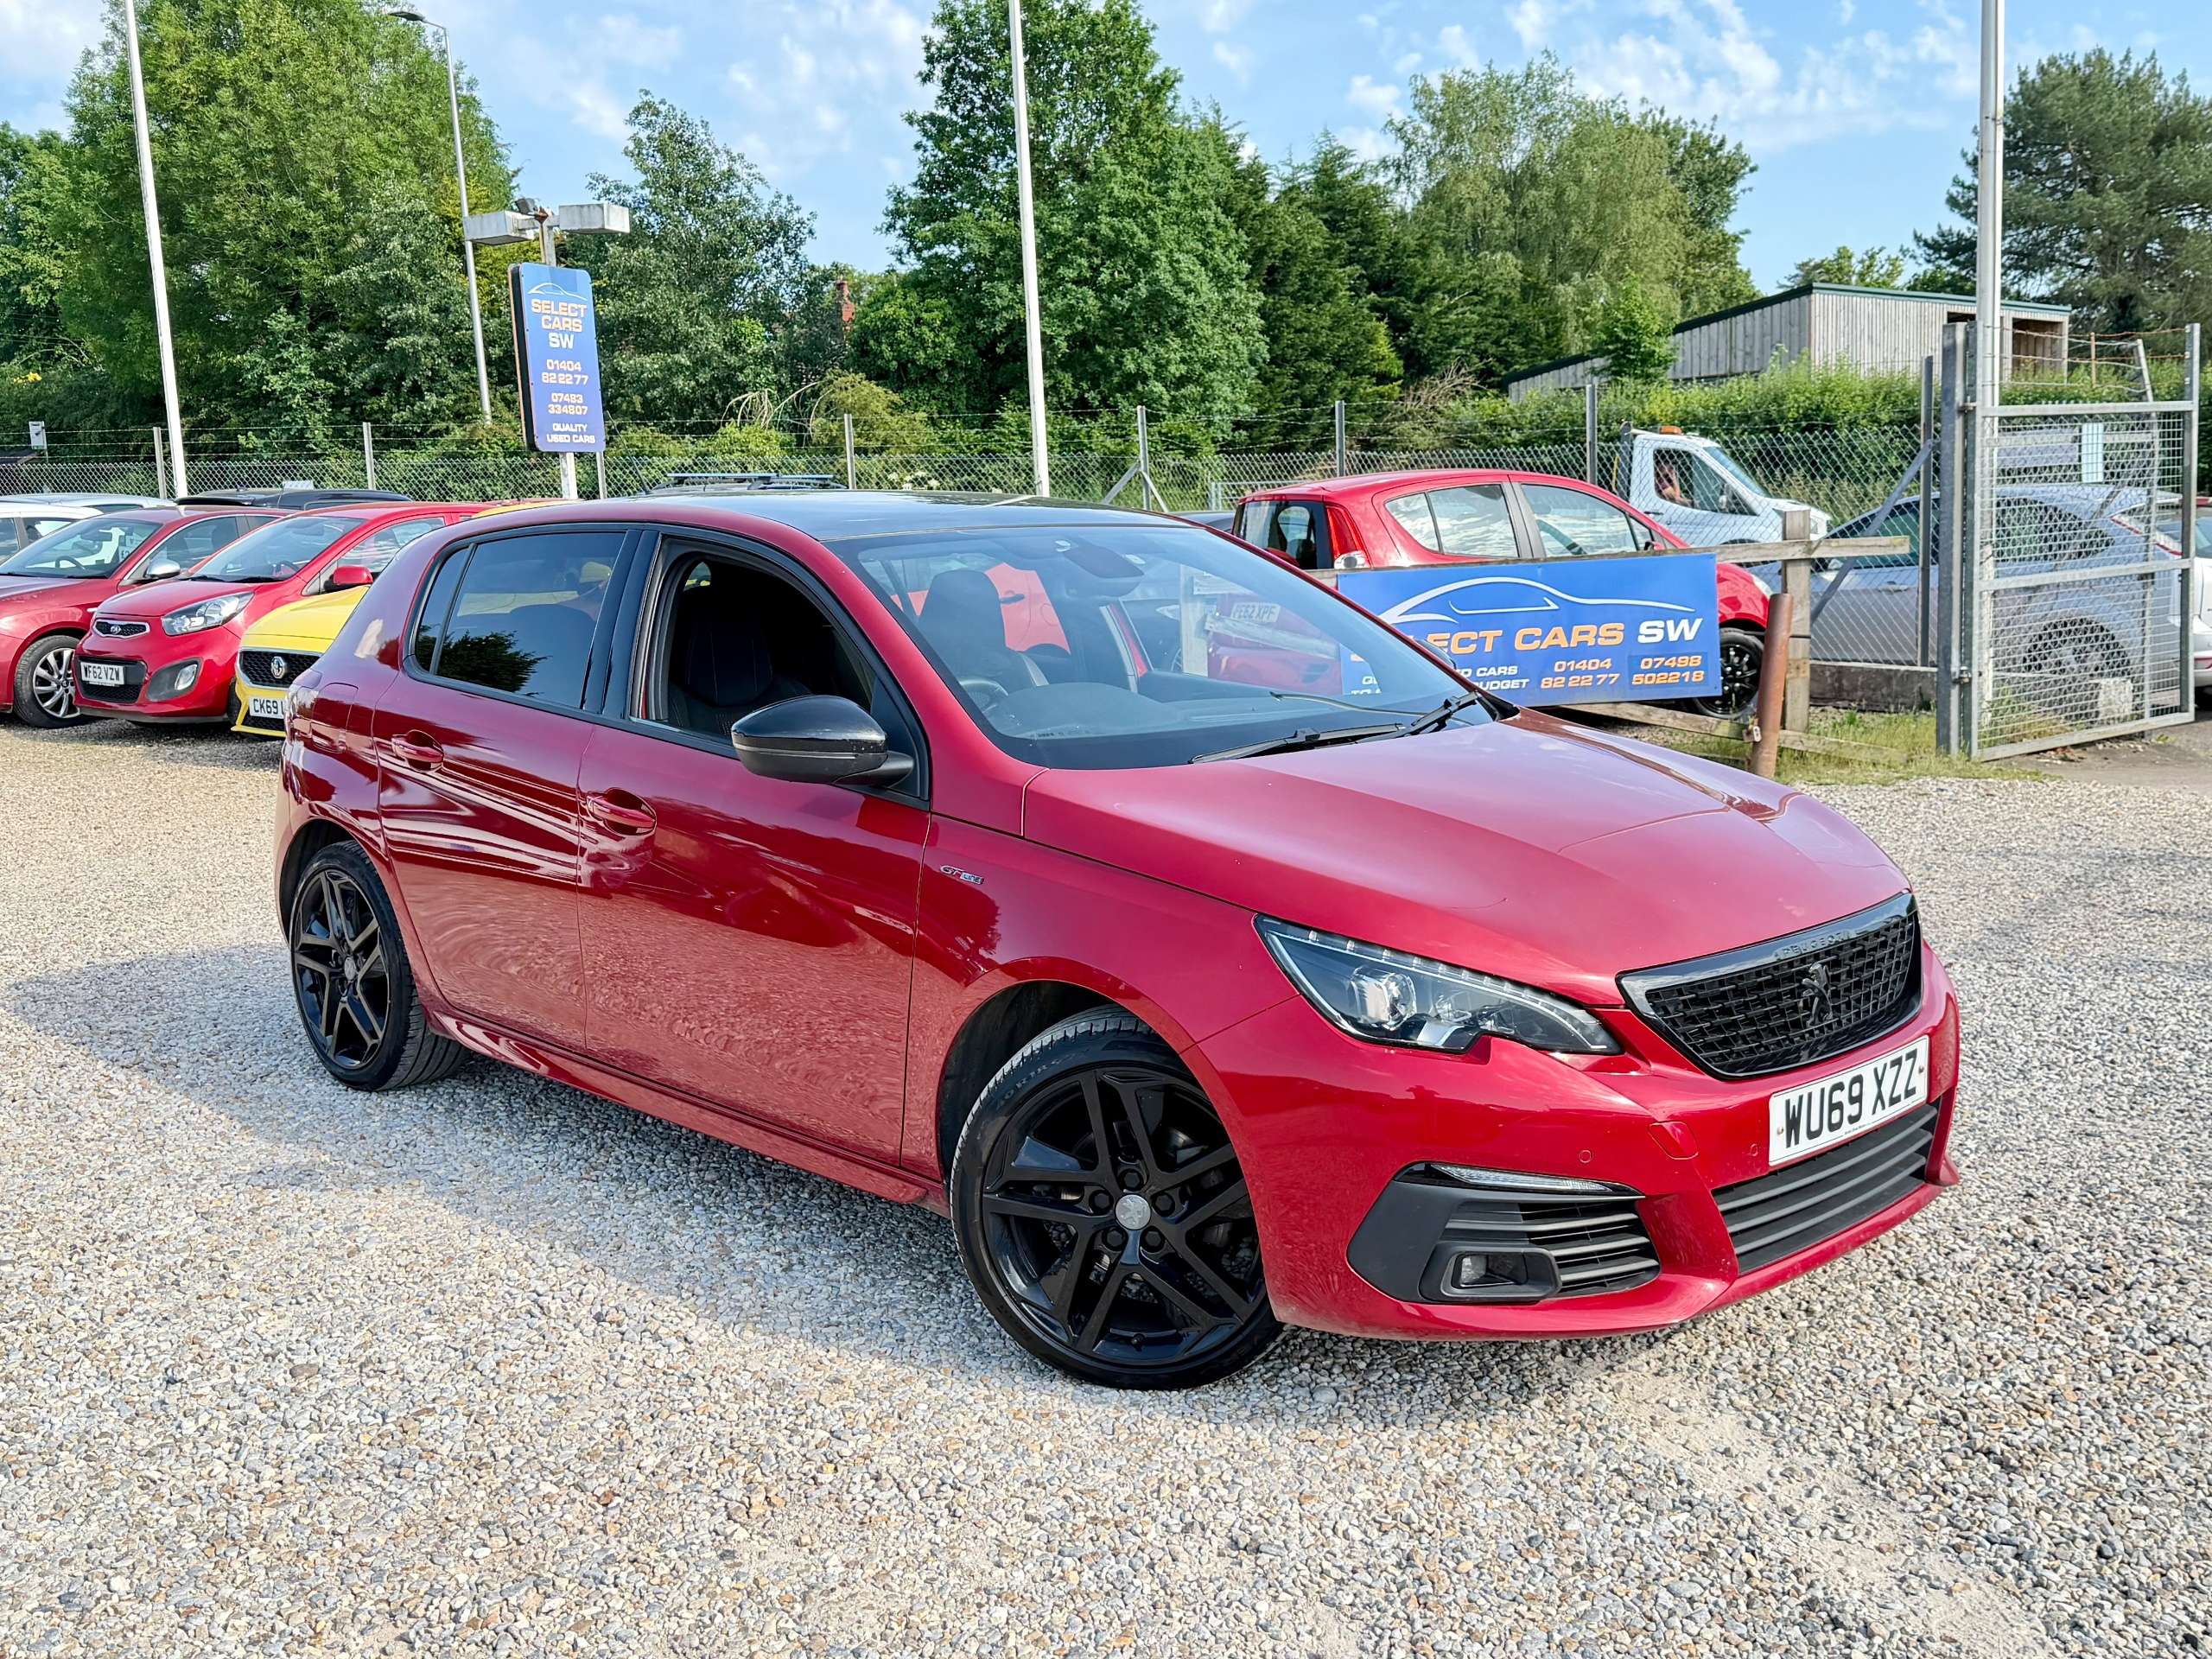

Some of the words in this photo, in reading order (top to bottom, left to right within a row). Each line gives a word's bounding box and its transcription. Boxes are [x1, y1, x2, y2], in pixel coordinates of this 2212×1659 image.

[531, 298, 587, 318] SELECT
[541, 315, 582, 333] CARS
[548, 332, 575, 349] SW
[546, 359, 582, 372] 01404
[552, 423, 588, 432] QUALITY
[546, 434, 570, 443] USED
[572, 434, 595, 444] CARS
[1514, 622, 1625, 651] CARS
[1637, 618, 1703, 644] SW
[1554, 658, 1611, 672] 01404
[1640, 655, 1701, 670] 07498
[1476, 665, 1518, 677] CARS
[1631, 671, 1705, 685] 502218
[253, 698, 278, 715] CK69
[939, 865, 964, 875] GT
[1784, 1073, 1864, 1148] WU69
[1872, 1048, 1917, 1116] XZZ
